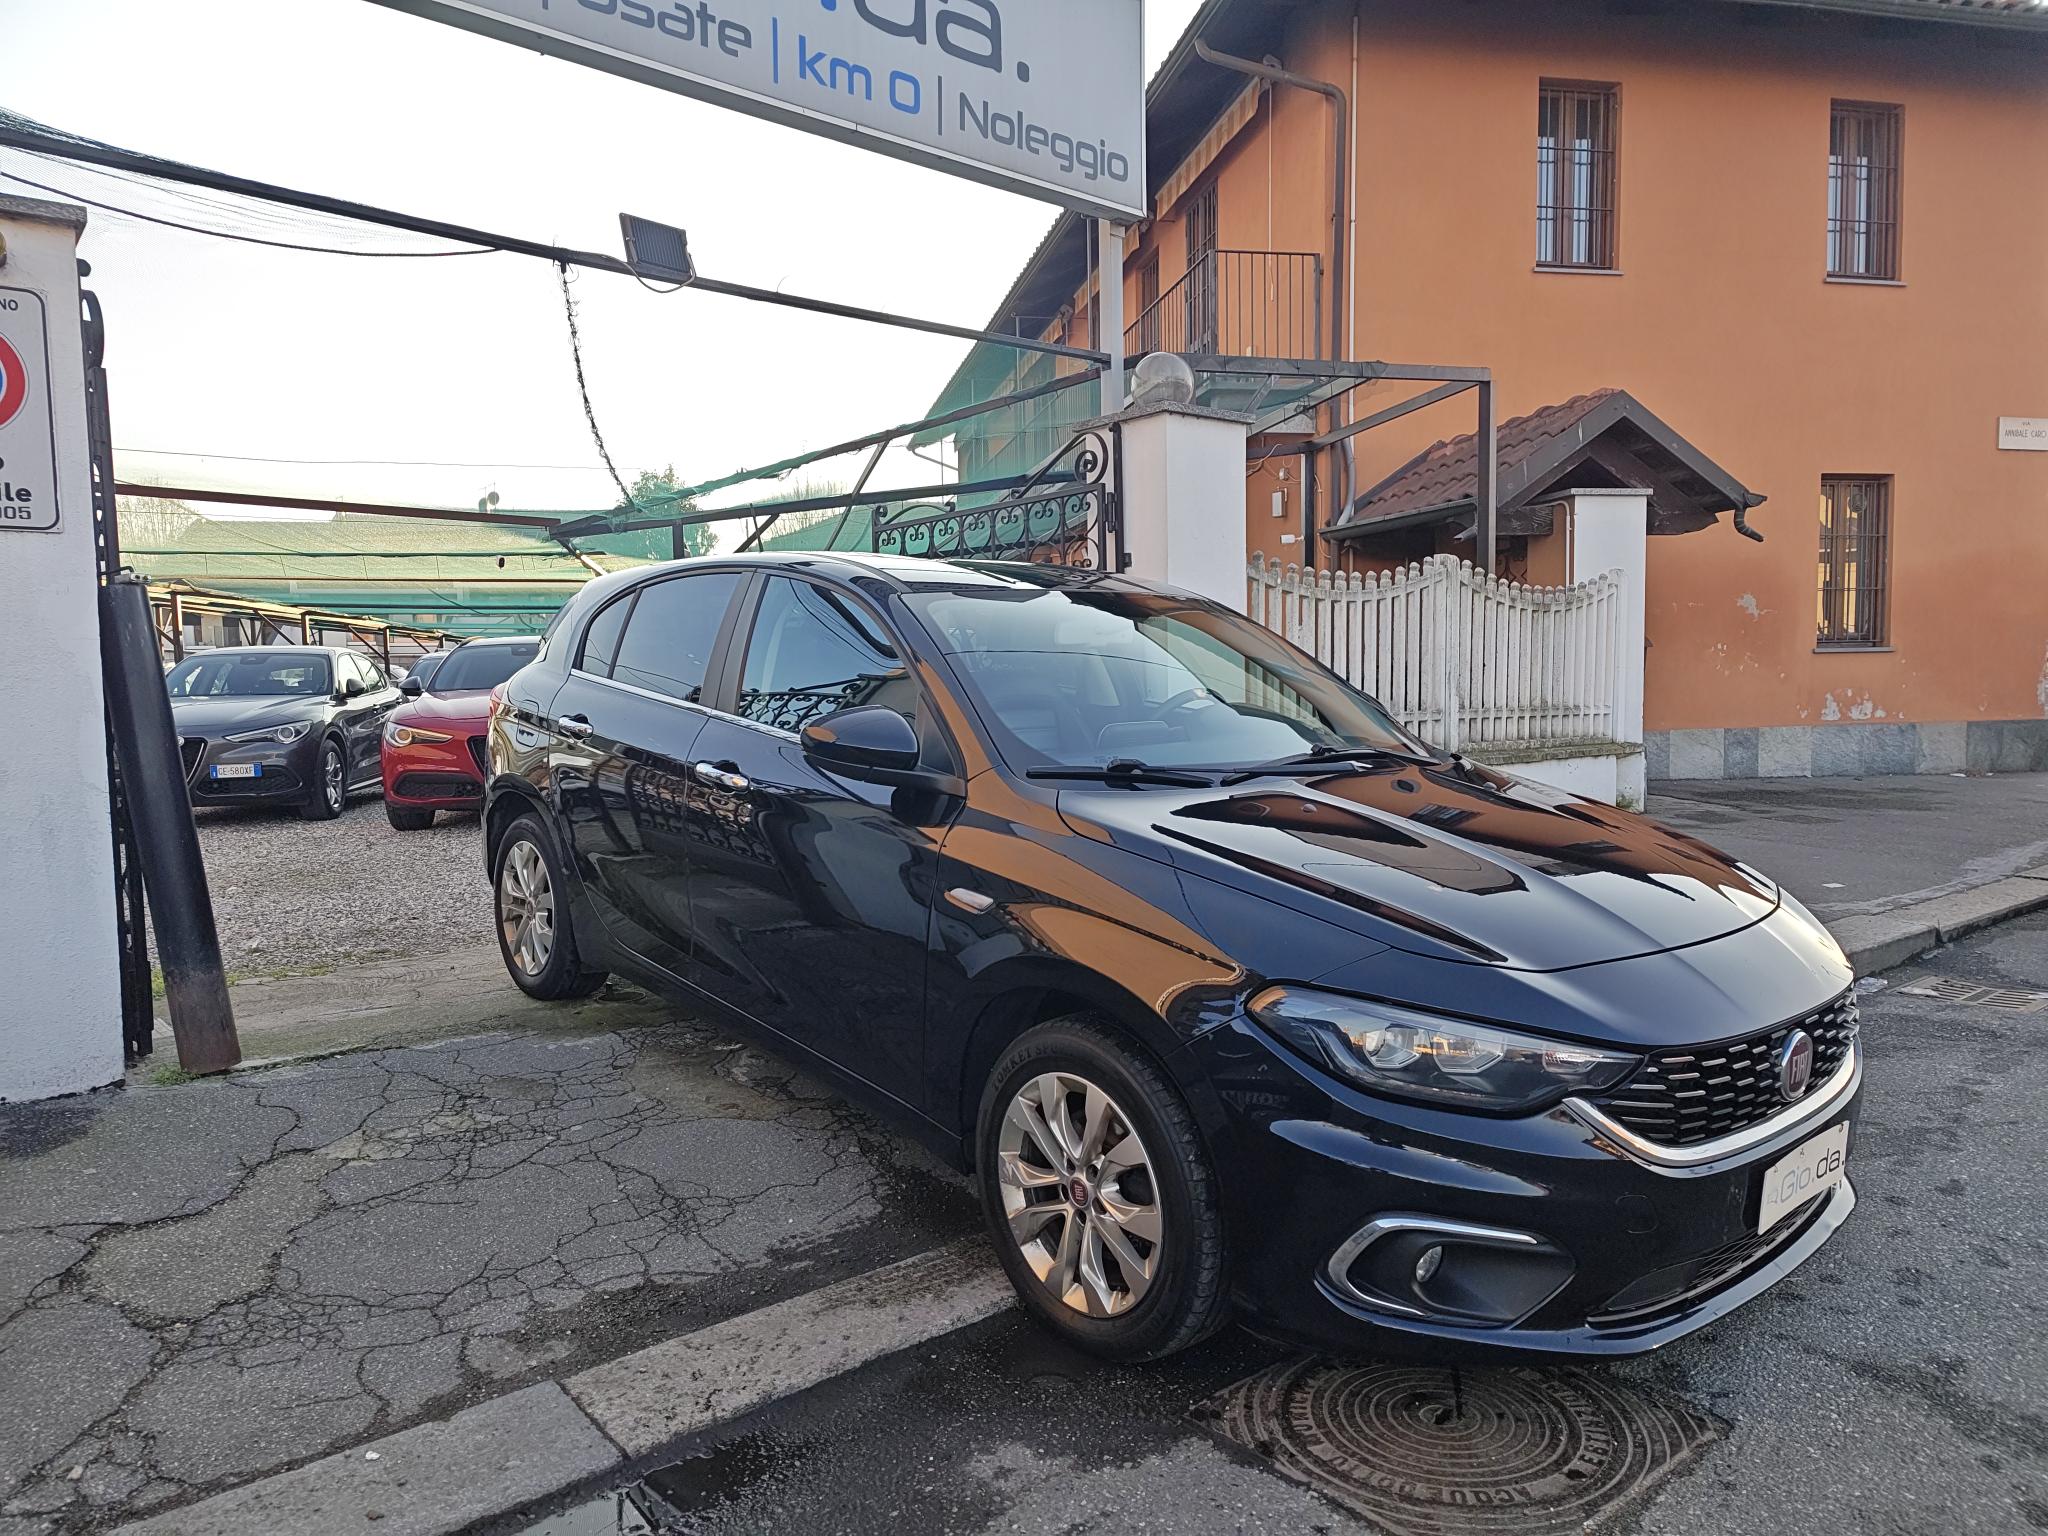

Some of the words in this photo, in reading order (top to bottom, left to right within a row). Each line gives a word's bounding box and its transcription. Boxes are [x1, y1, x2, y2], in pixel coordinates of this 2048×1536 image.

[798, 34, 872, 101] km
[959, 92, 1129, 182] Noleggio
[0, 481, 33, 502] le
[0, 506, 32, 520] 05
[1790, 1050, 1809, 1085] FIAT
[1074, 1183, 1085, 1201] FIAT
